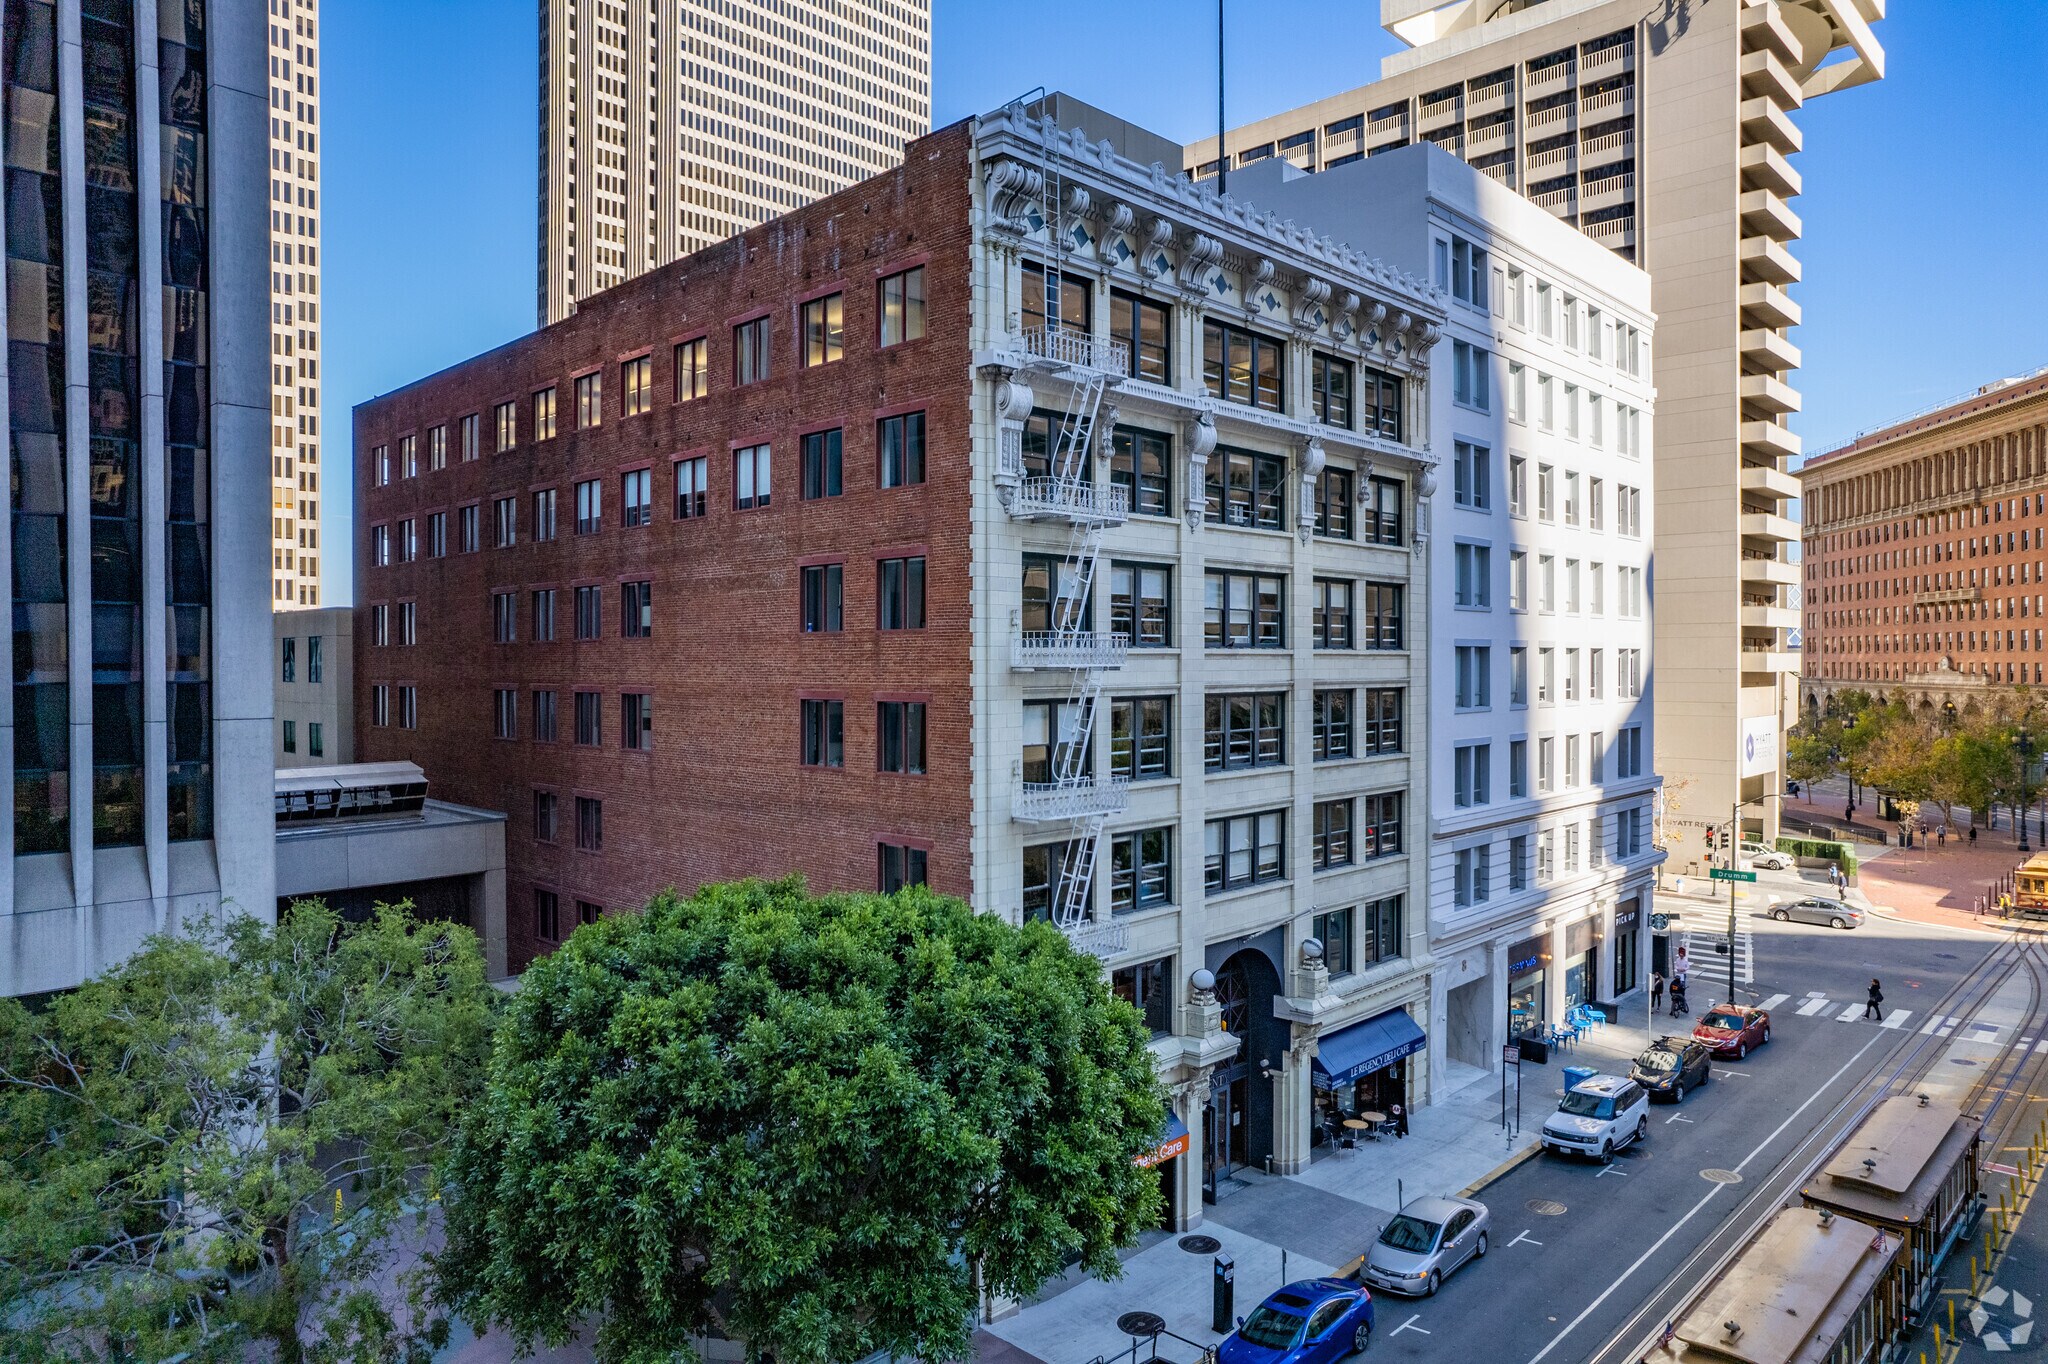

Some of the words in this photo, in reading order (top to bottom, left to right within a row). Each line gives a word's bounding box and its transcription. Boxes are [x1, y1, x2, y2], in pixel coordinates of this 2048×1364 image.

[1717, 871, 1748, 880] Drumm
[1615, 915, 1628, 926] PICK
[1350, 1065, 1358, 1078] LE
[1358, 1055, 1384, 1074] REGENCY
[1384, 1049, 1397, 1063] DELI
[1396, 1043, 1411, 1057] CAFE
[1160, 1141, 1183, 1159] Care
